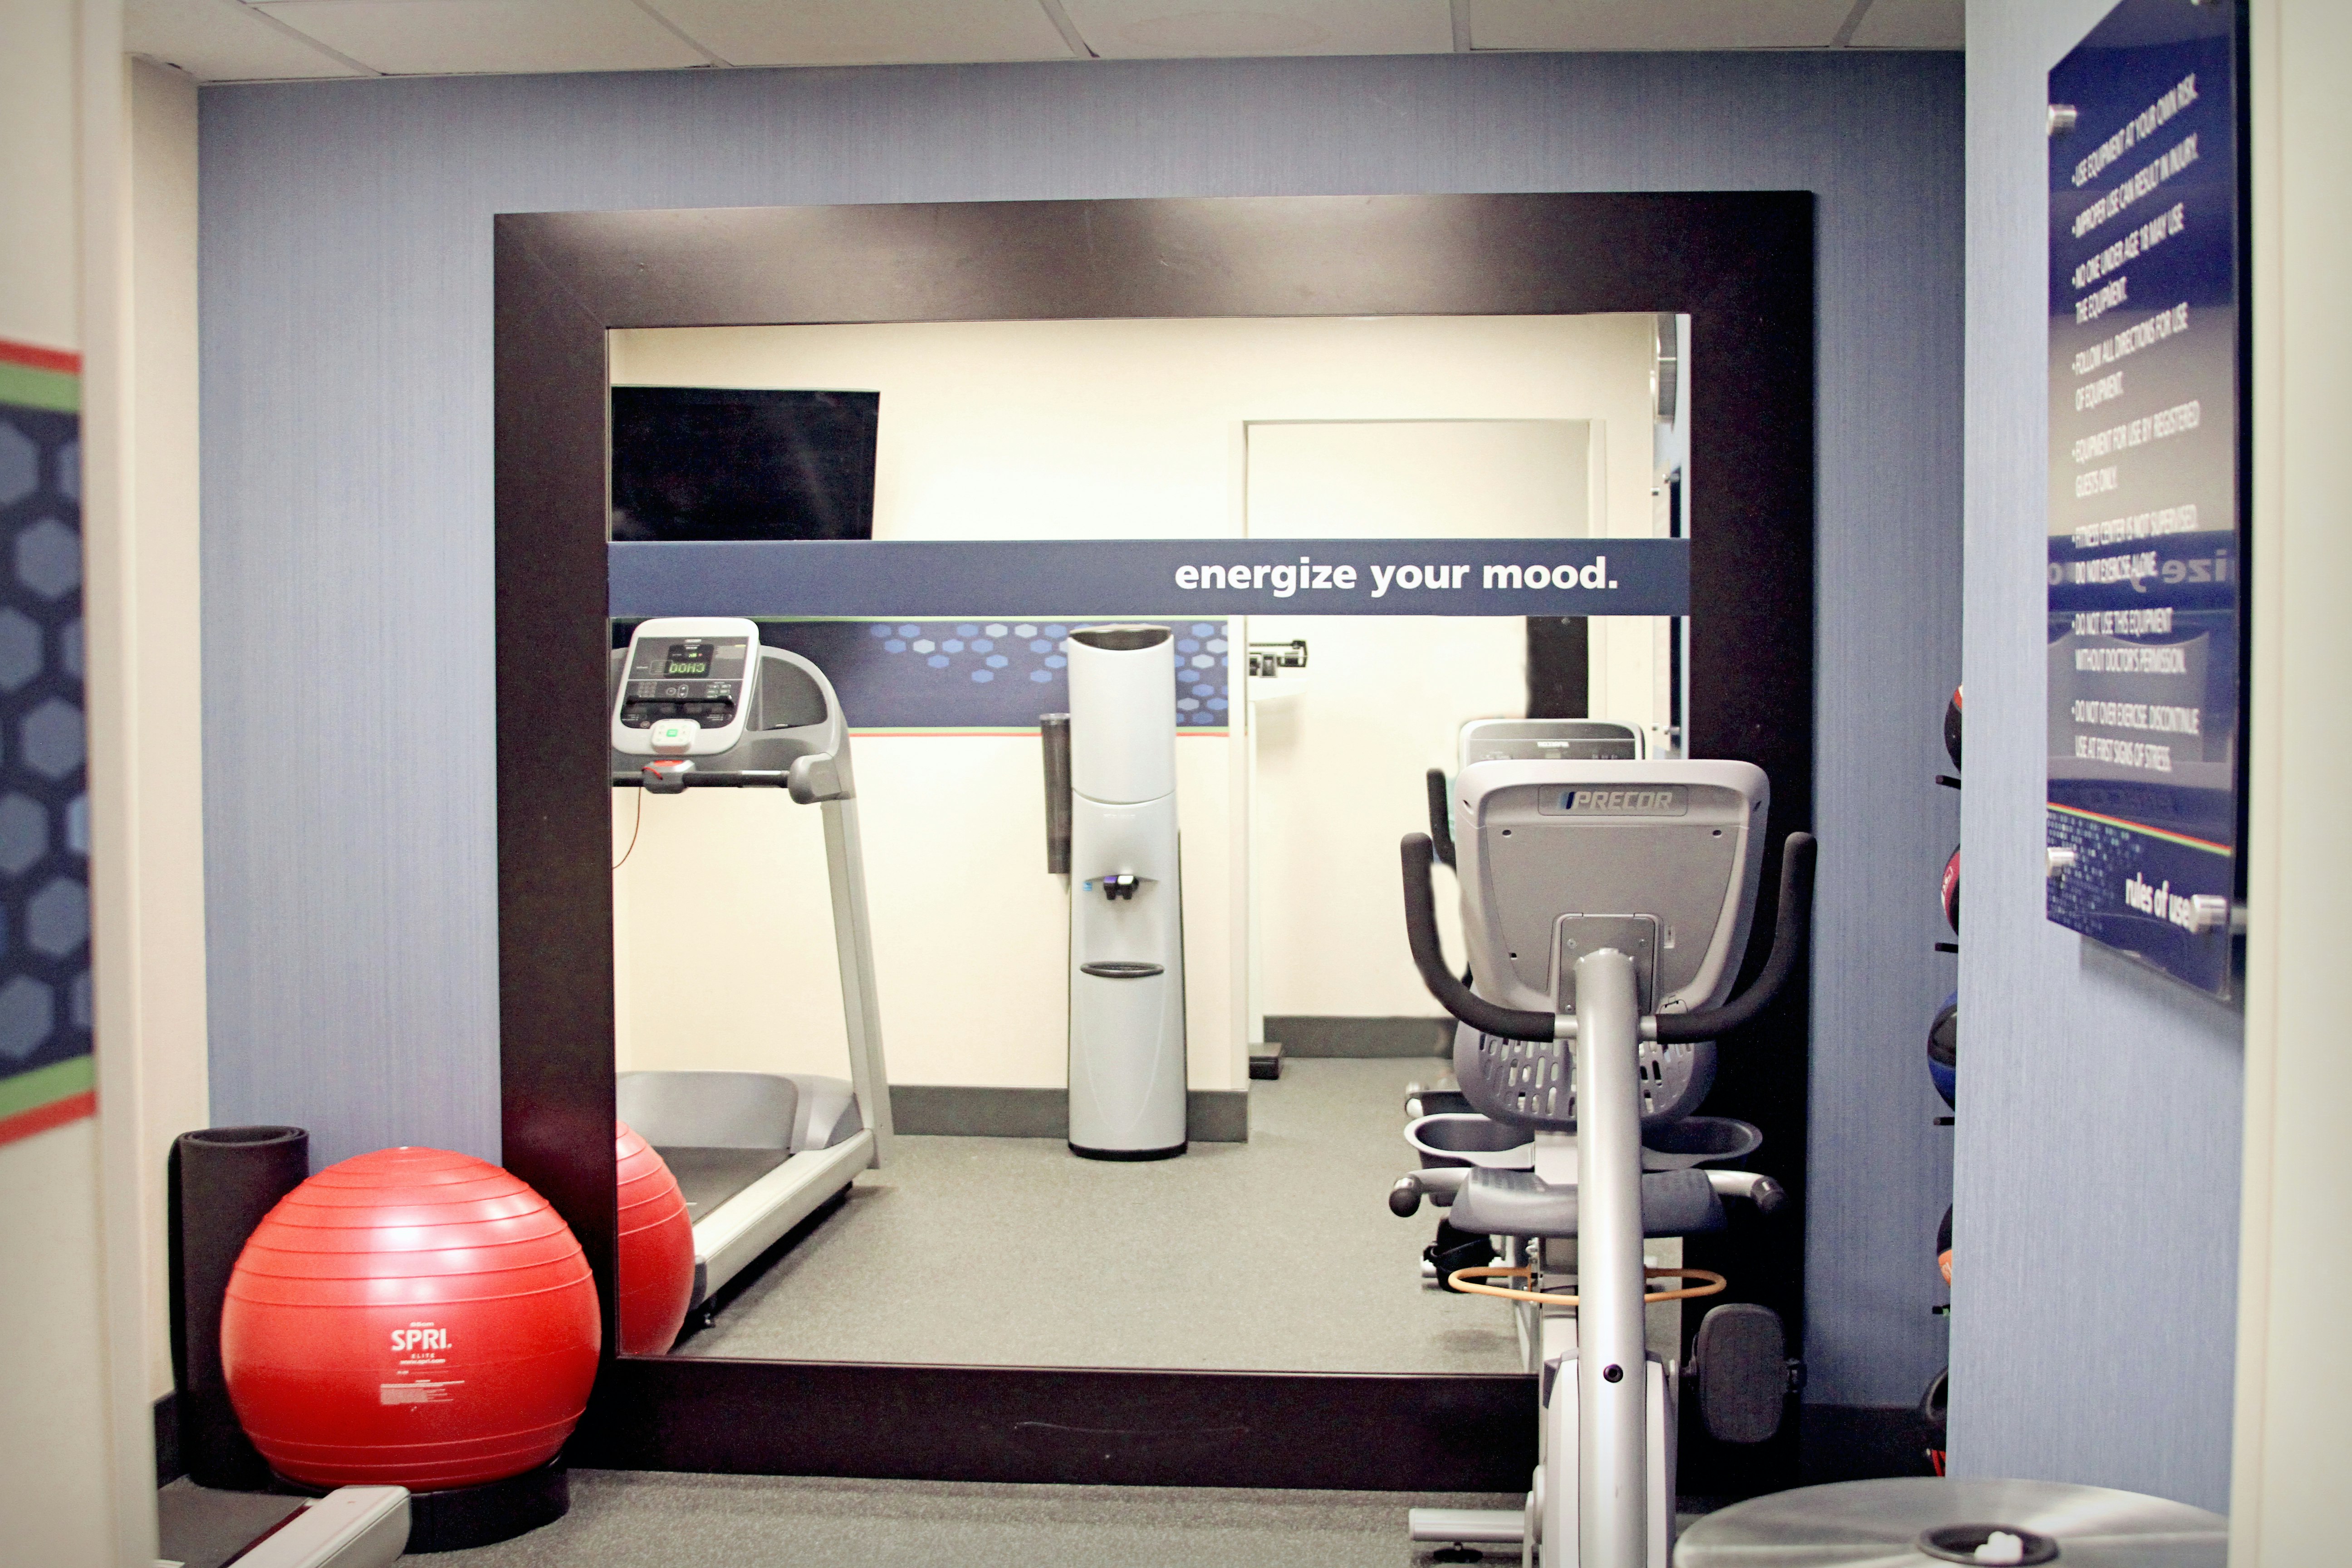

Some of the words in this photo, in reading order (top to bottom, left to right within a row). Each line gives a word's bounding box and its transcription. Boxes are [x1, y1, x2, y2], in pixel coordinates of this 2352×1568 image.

[2075, 156, 2087, 189] USE
[2087, 127, 2124, 182] EQUIPMENT
[2125, 119, 2135, 153] AT
[2136, 103, 2156, 145] YOUR
[2156, 86, 2177, 129] OWN
[2075, 196, 2106, 240] IMPROPER
[2106, 186, 2119, 220] USE
[2119, 176, 2134, 211] CAN
[2134, 158, 2159, 201] RESULT
[2160, 152, 2169, 184] IN
[2075, 261, 2086, 291] NO
[2086, 253, 2100, 285] ONE
[2101, 239, 2123, 277] UNDER
[2124, 228, 2140, 263] AGE
[2149, 212, 2166, 249] MAY
[2167, 201, 2184, 238] USE
[2075, 297, 2088, 326] THE
[2076, 343, 2101, 377] FOLLOW
[2102, 336, 2114, 366] ALL
[2115, 317, 2155, 360] DIRECTIONS
[2156, 309, 2171, 342] FOR
[2172, 301, 2188, 335] USE
[2076, 387, 2085, 412] OF
[2076, 429, 2112, 465] EQUIPMENT
[2113, 424, 2127, 452] FOR
[2128, 419, 2142, 447] USE
[2142, 415, 2152, 443] BY
[2153, 399, 2200, 440] REGISTERED
[2076, 470, 2098, 499] GUESTS
[2075, 523, 2099, 549] FITNESS
[2100, 518, 2125, 545] CENTER
[2127, 516, 2132, 540] IS
[2133, 513, 2150, 539] NOT
[1176, 557, 1357, 598] energize
[1371, 565, 1470, 598] your
[1484, 556, 1617, 588] mood.
[2075, 561, 2085, 584] DO
[2086, 559, 2100, 583] NOT
[2101, 554, 2131, 582] EXERCISE
[2075, 613, 2085, 636] DO
[2086, 612, 2100, 635] NOT
[2101, 611, 2114, 635] USE
[2114, 610, 2129, 634] THIS
[2075, 649, 2105, 671] WITHOUT
[2075, 700, 2084, 723] DO
[2085, 701, 2099, 724] NOT
[2099, 701, 2117, 726] OVER
[2149, 705, 2199, 735] DISCONTINUE
[2075, 735, 2087, 759] USE
[2088, 736, 2096, 760] AT
[2097, 737, 2113, 763] FIRST
[2113, 740, 2133, 766] SIGNS
[2134, 742, 2144, 768] OF
[1571, 791, 1672, 811] PRECOR
[2125, 872, 2153, 914] rules
[2154, 880, 2169, 919] of
